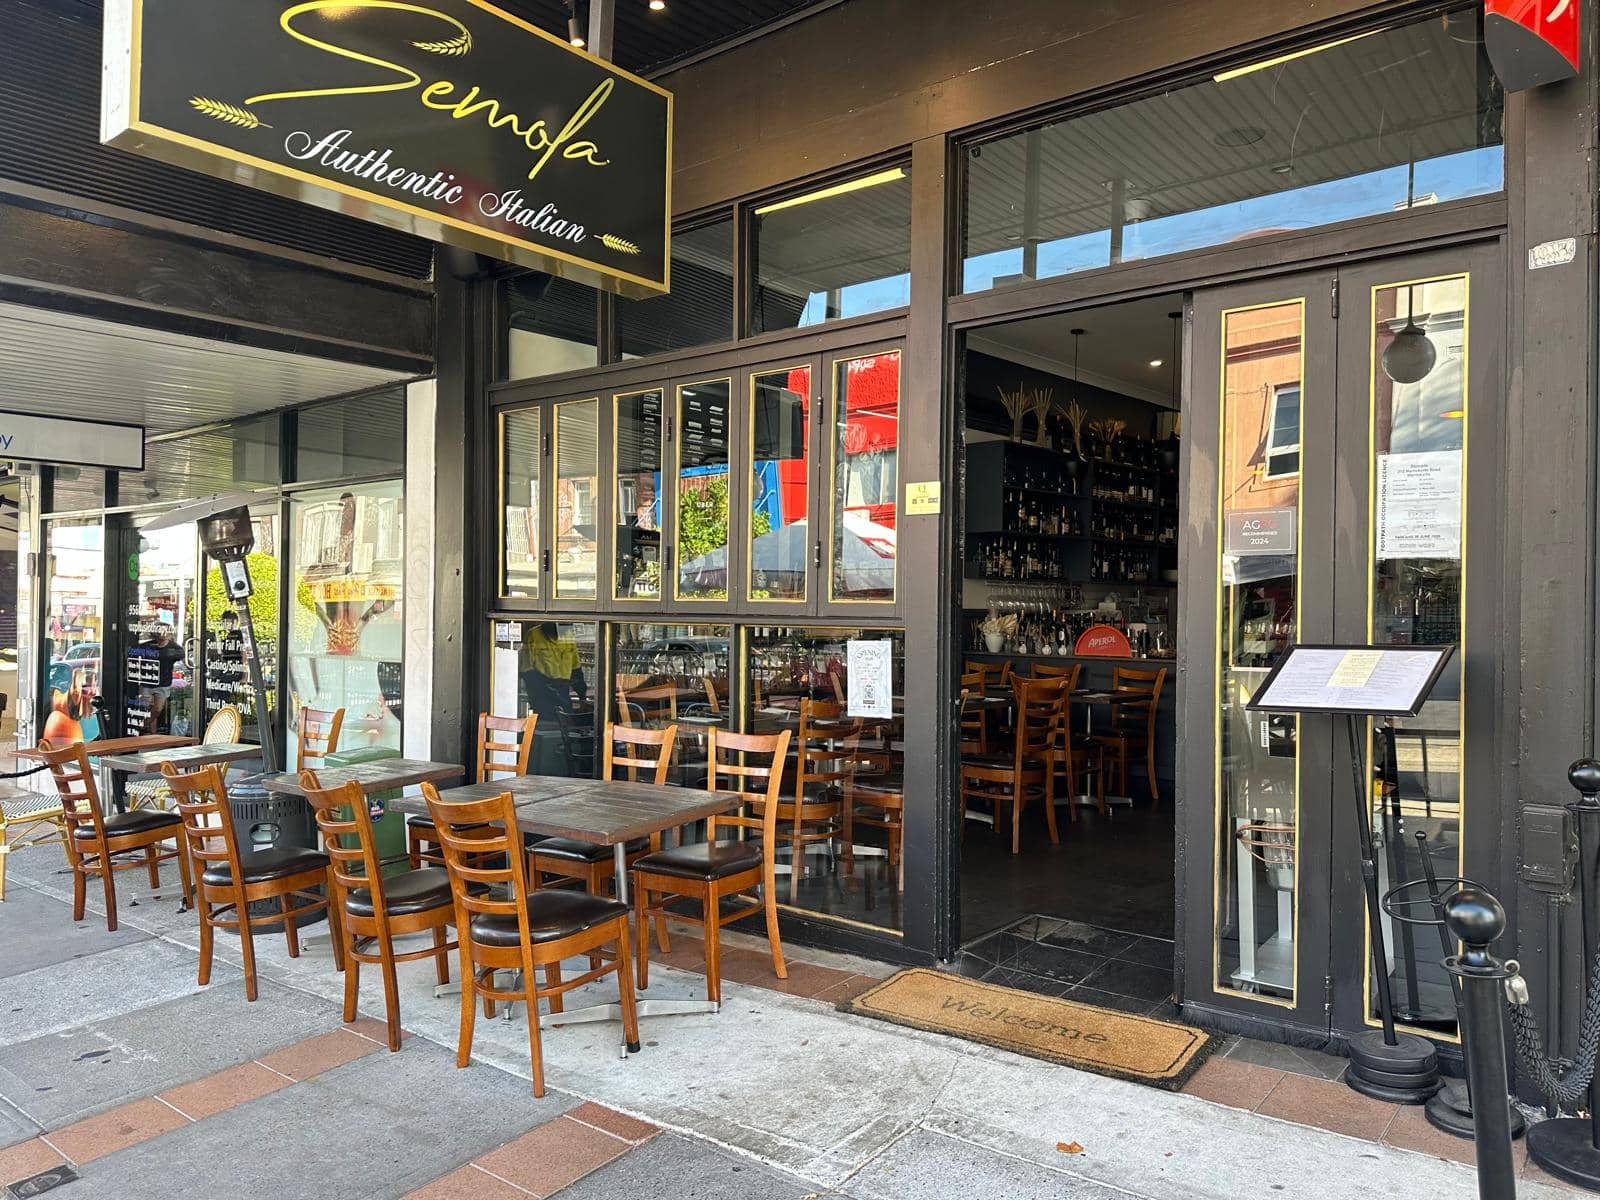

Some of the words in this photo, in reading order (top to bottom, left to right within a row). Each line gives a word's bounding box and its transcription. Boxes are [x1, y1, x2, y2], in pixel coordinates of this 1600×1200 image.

[244, 0, 612, 179] Semola
[284, 128, 464, 205] Authentic
[479, 189, 587, 244] Italian
[1087, 635, 1116, 648] APEROL
[205, 697, 221, 710] Third
[941, 995, 1108, 1044] Welcome
